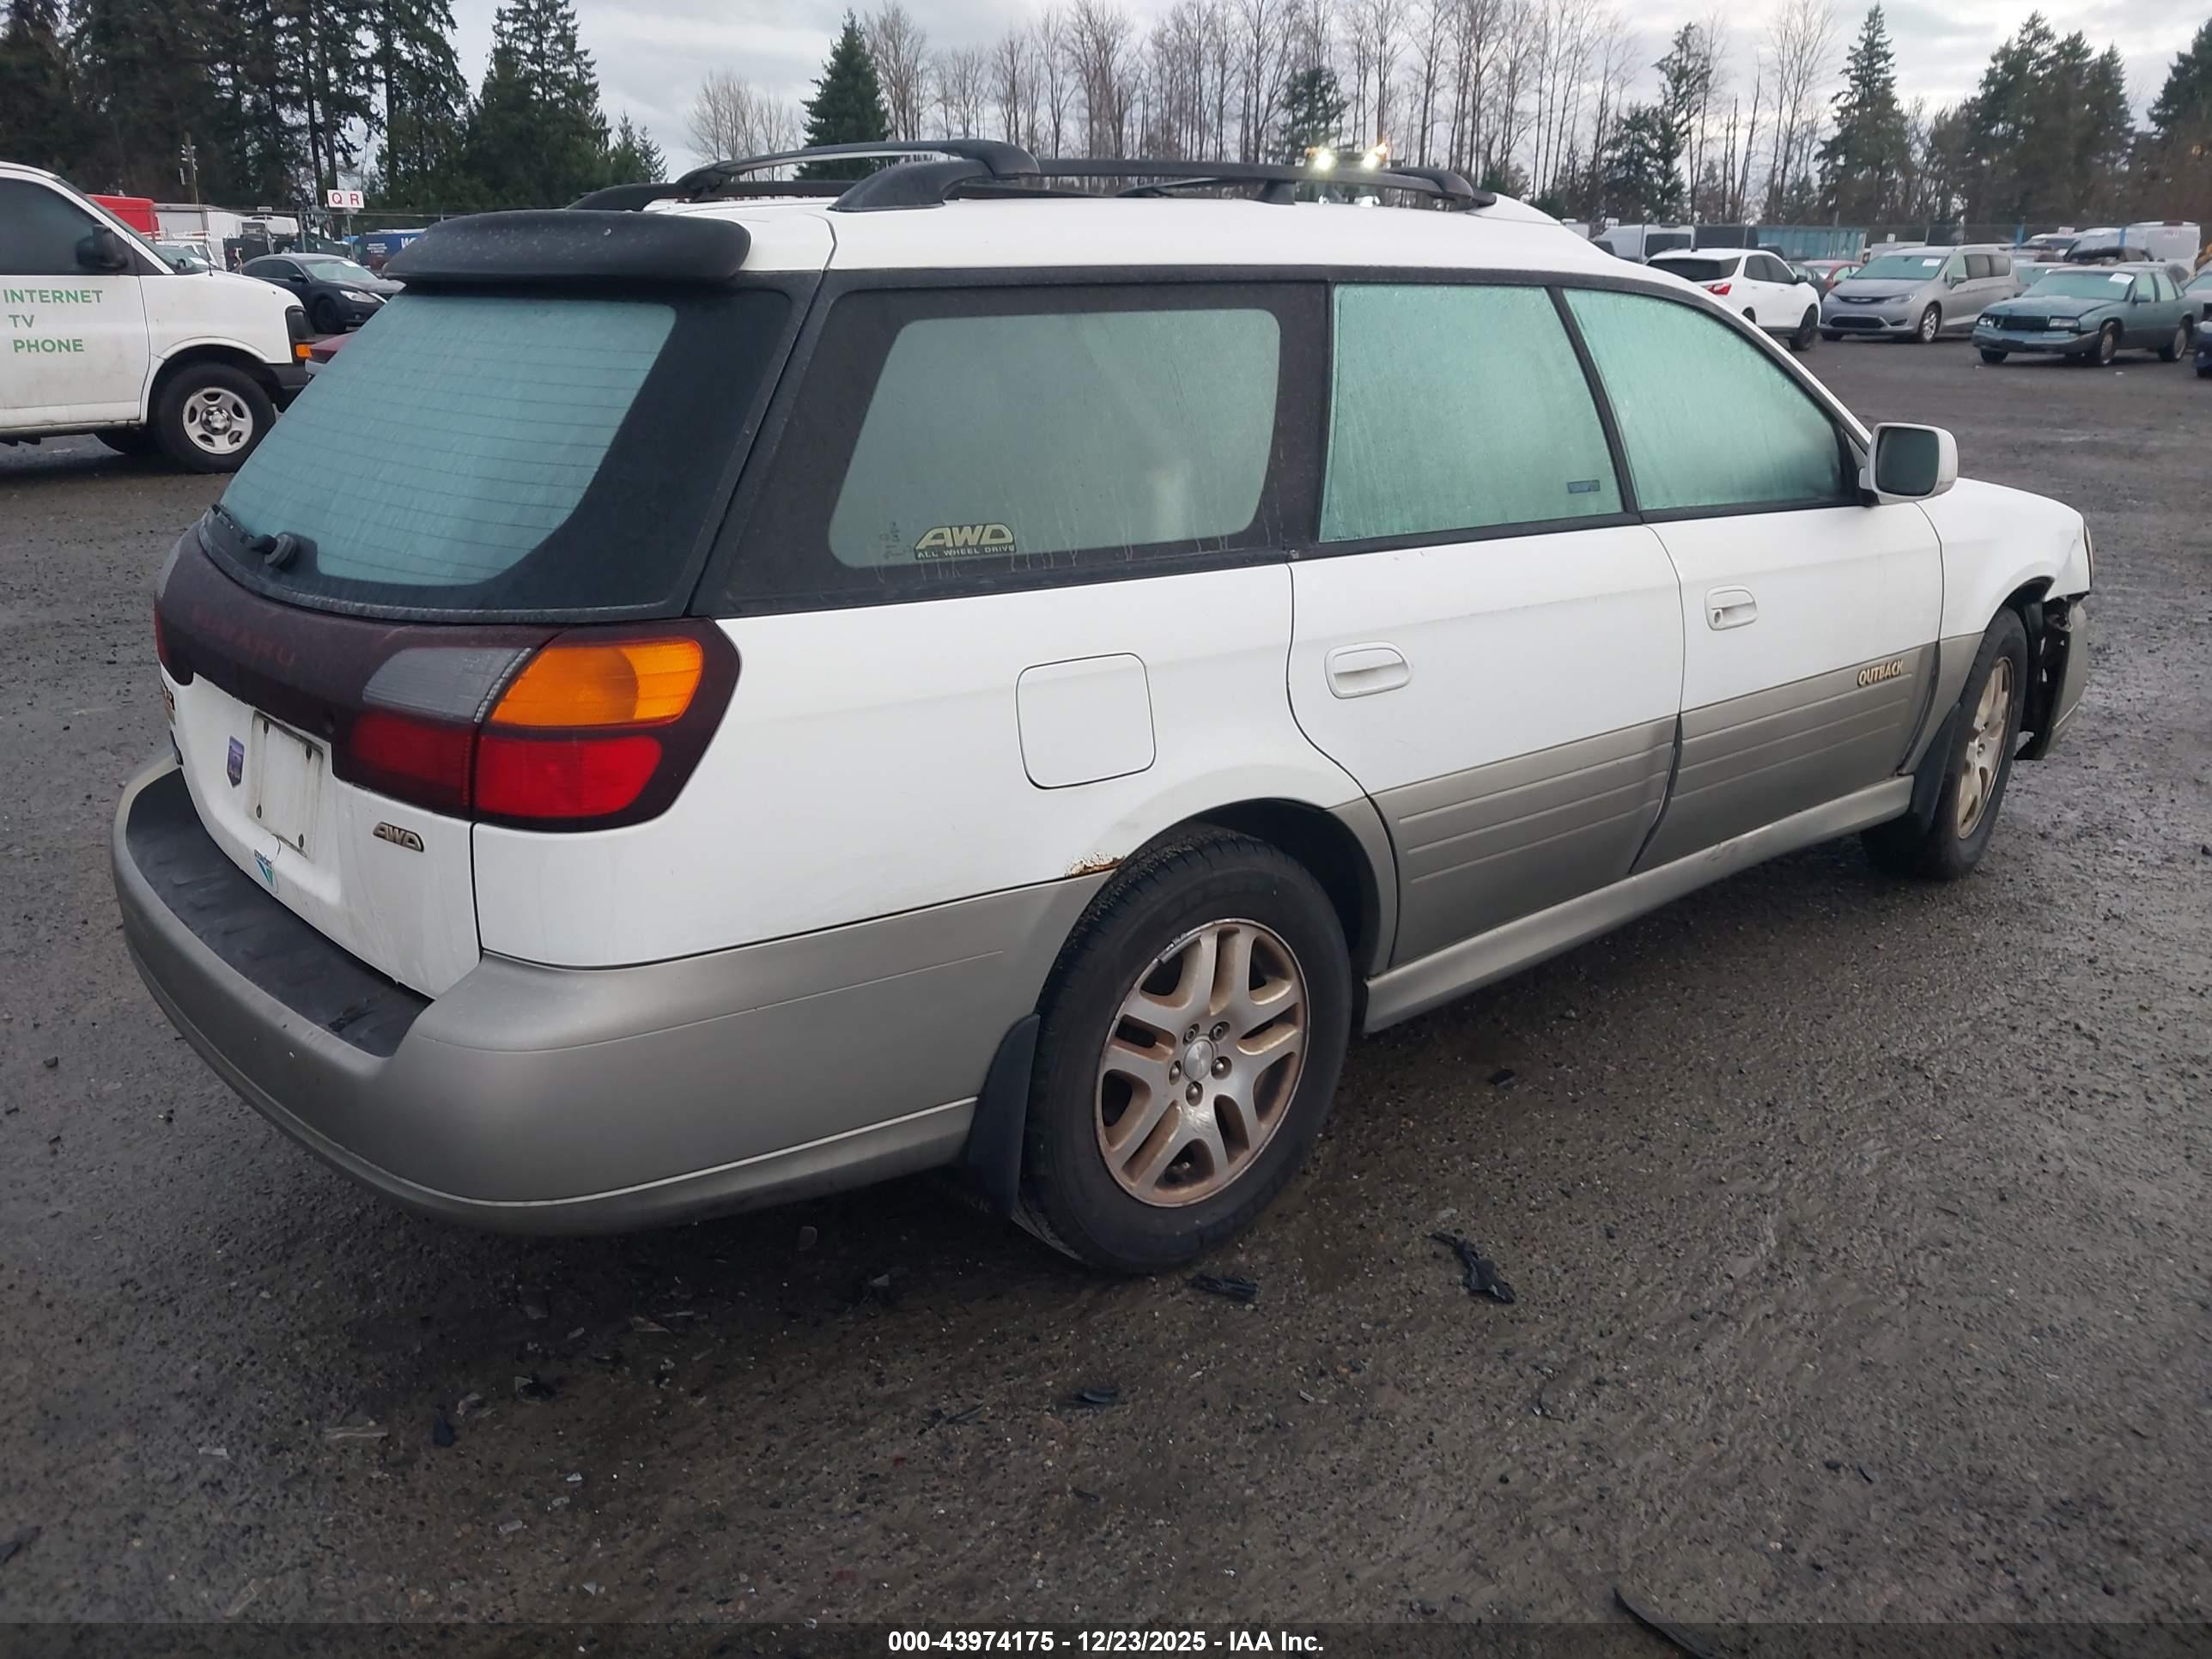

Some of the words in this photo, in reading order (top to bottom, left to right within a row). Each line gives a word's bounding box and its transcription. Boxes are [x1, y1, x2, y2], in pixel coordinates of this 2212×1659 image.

[331, 192, 343, 205] Q
[349, 193, 360, 205] R
[3, 289, 103, 303] INTERNET
[8, 314, 35, 328] TV
[13, 338, 85, 353] PHONE
[915, 523, 1015, 550] AWD
[917, 550, 939, 559] ALL
[943, 547, 981, 557] WHEEL
[1857, 659, 1904, 686] OUTBACK
[373, 822, 424, 852] AWD
